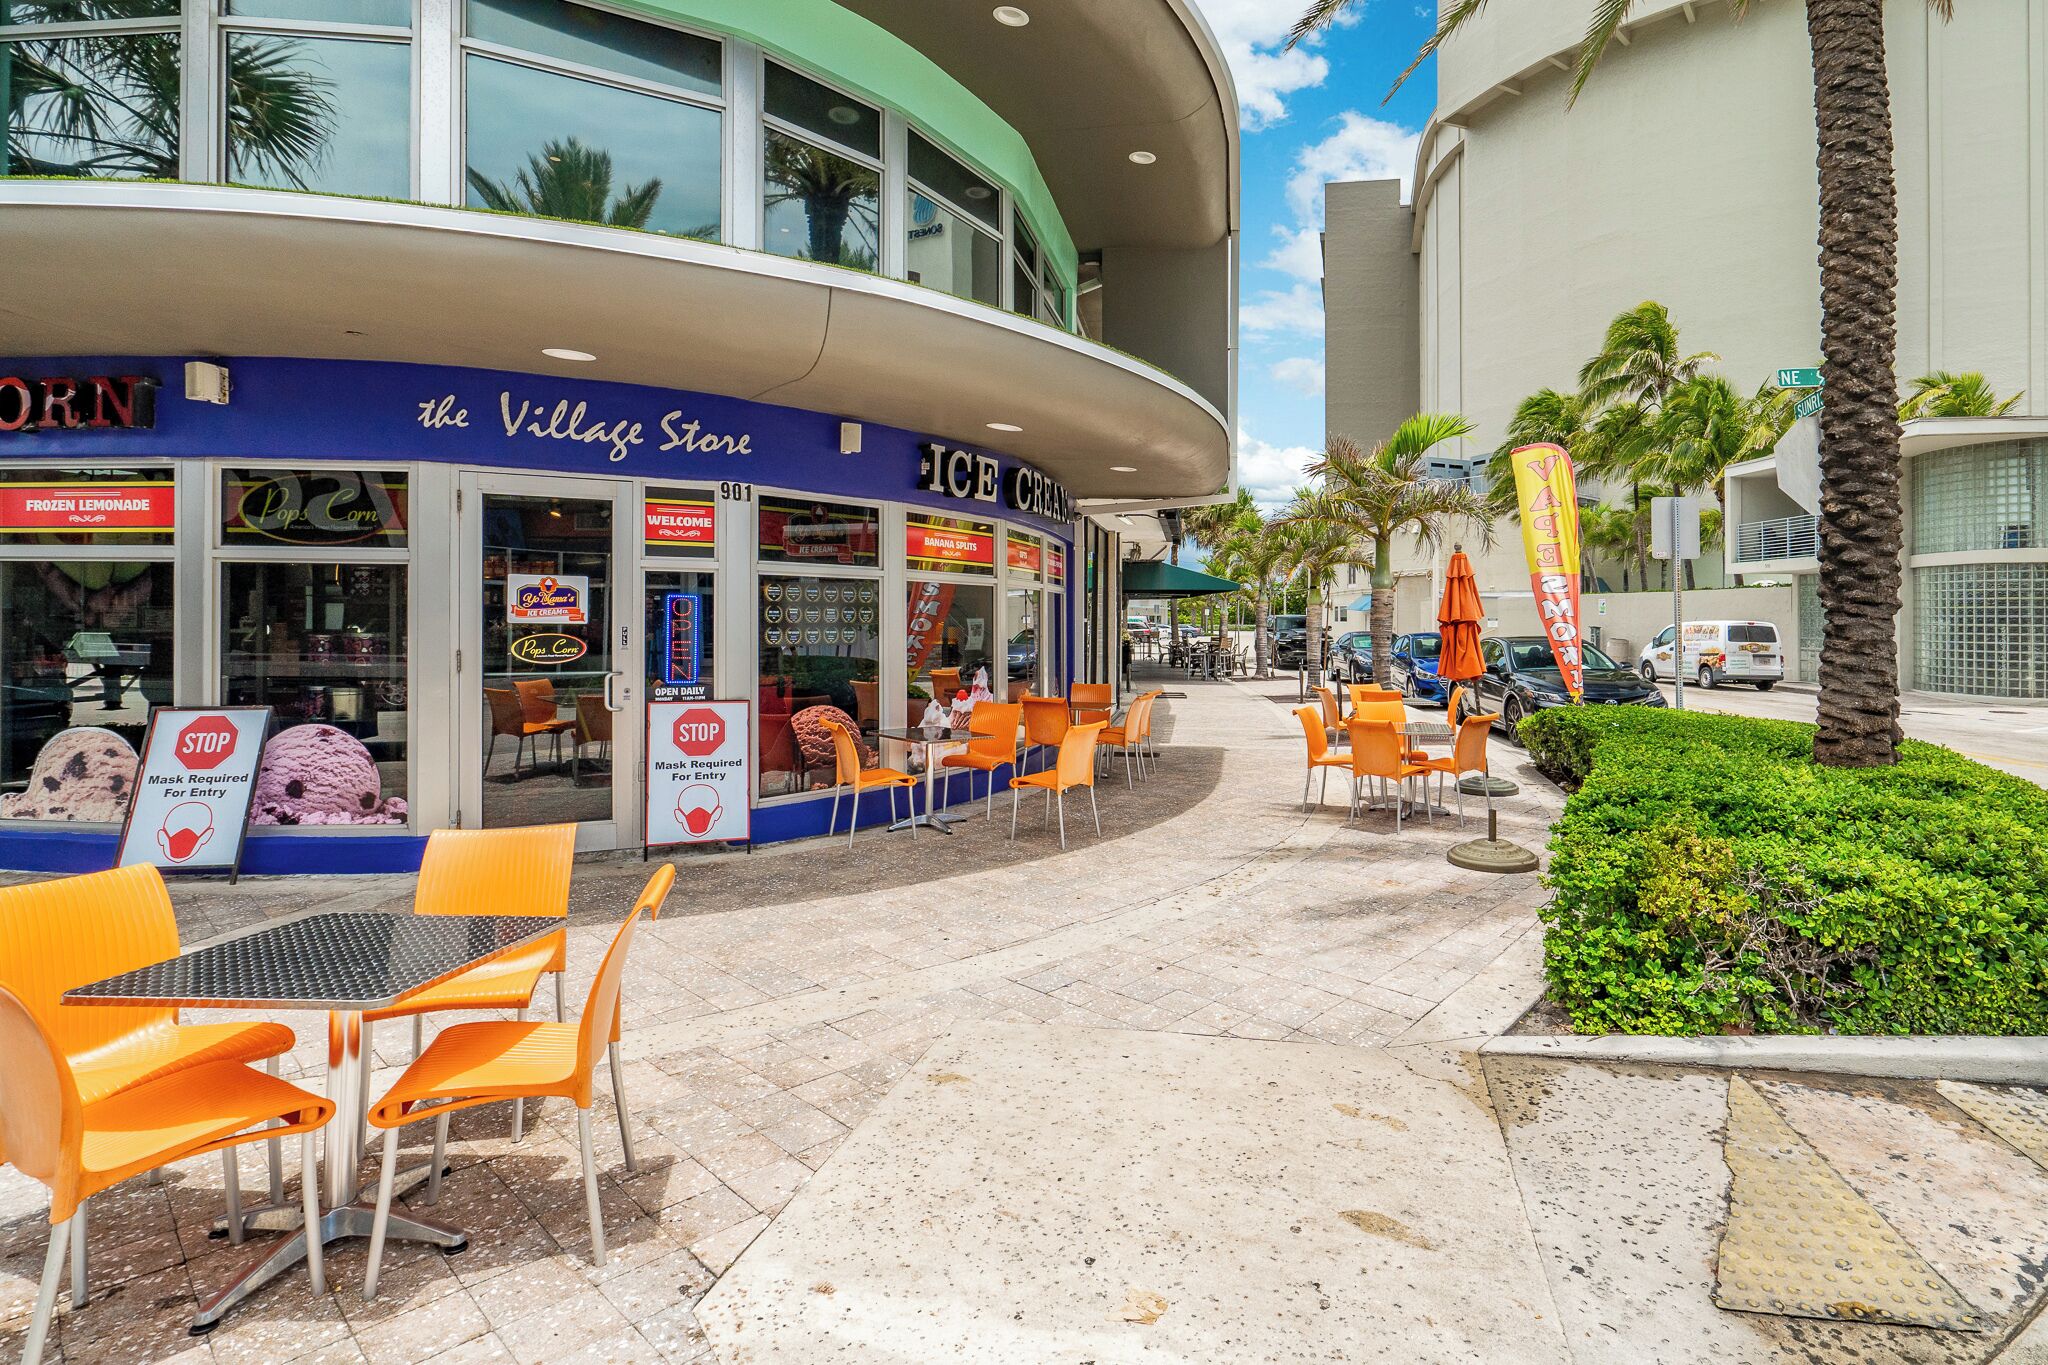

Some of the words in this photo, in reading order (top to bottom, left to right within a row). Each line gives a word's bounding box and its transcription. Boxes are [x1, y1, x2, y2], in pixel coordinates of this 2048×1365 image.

[1781, 371, 1801, 385] NE
[418, 394, 469, 429] the
[500, 391, 643, 462] Village
[659, 410, 752, 455] Store
[929, 443, 999, 503] ICE
[720, 482, 751, 502] 901
[25, 499, 76, 512] FROZEN
[79, 499, 150, 512] LEMONADE
[260, 487, 308, 530] Pops
[326, 488, 379, 521] Corn
[646, 515, 712, 528] WELCOME
[924, 537, 955, 549] BANANA
[956, 541, 977, 552] SPLITS
[523, 592, 539, 608] Yo
[539, 591, 575, 606] Mama's
[671, 598, 692, 681] OPEN
[521, 639, 546, 658] Pops
[552, 638, 578, 654] Corn
[655, 687, 679, 696] OPEN
[680, 686, 705, 696] DAILY
[679, 722, 720, 742] STOP
[182, 732, 231, 754] STOP
[655, 760, 687, 770] Mask
[691, 758, 742, 769] Required
[148, 775, 184, 785] Mask
[188, 773, 249, 786] Required
[672, 772, 691, 782] For
[694, 771, 726, 781] Entry
[164, 788, 186, 798] For
[190, 787, 227, 799] Entry
